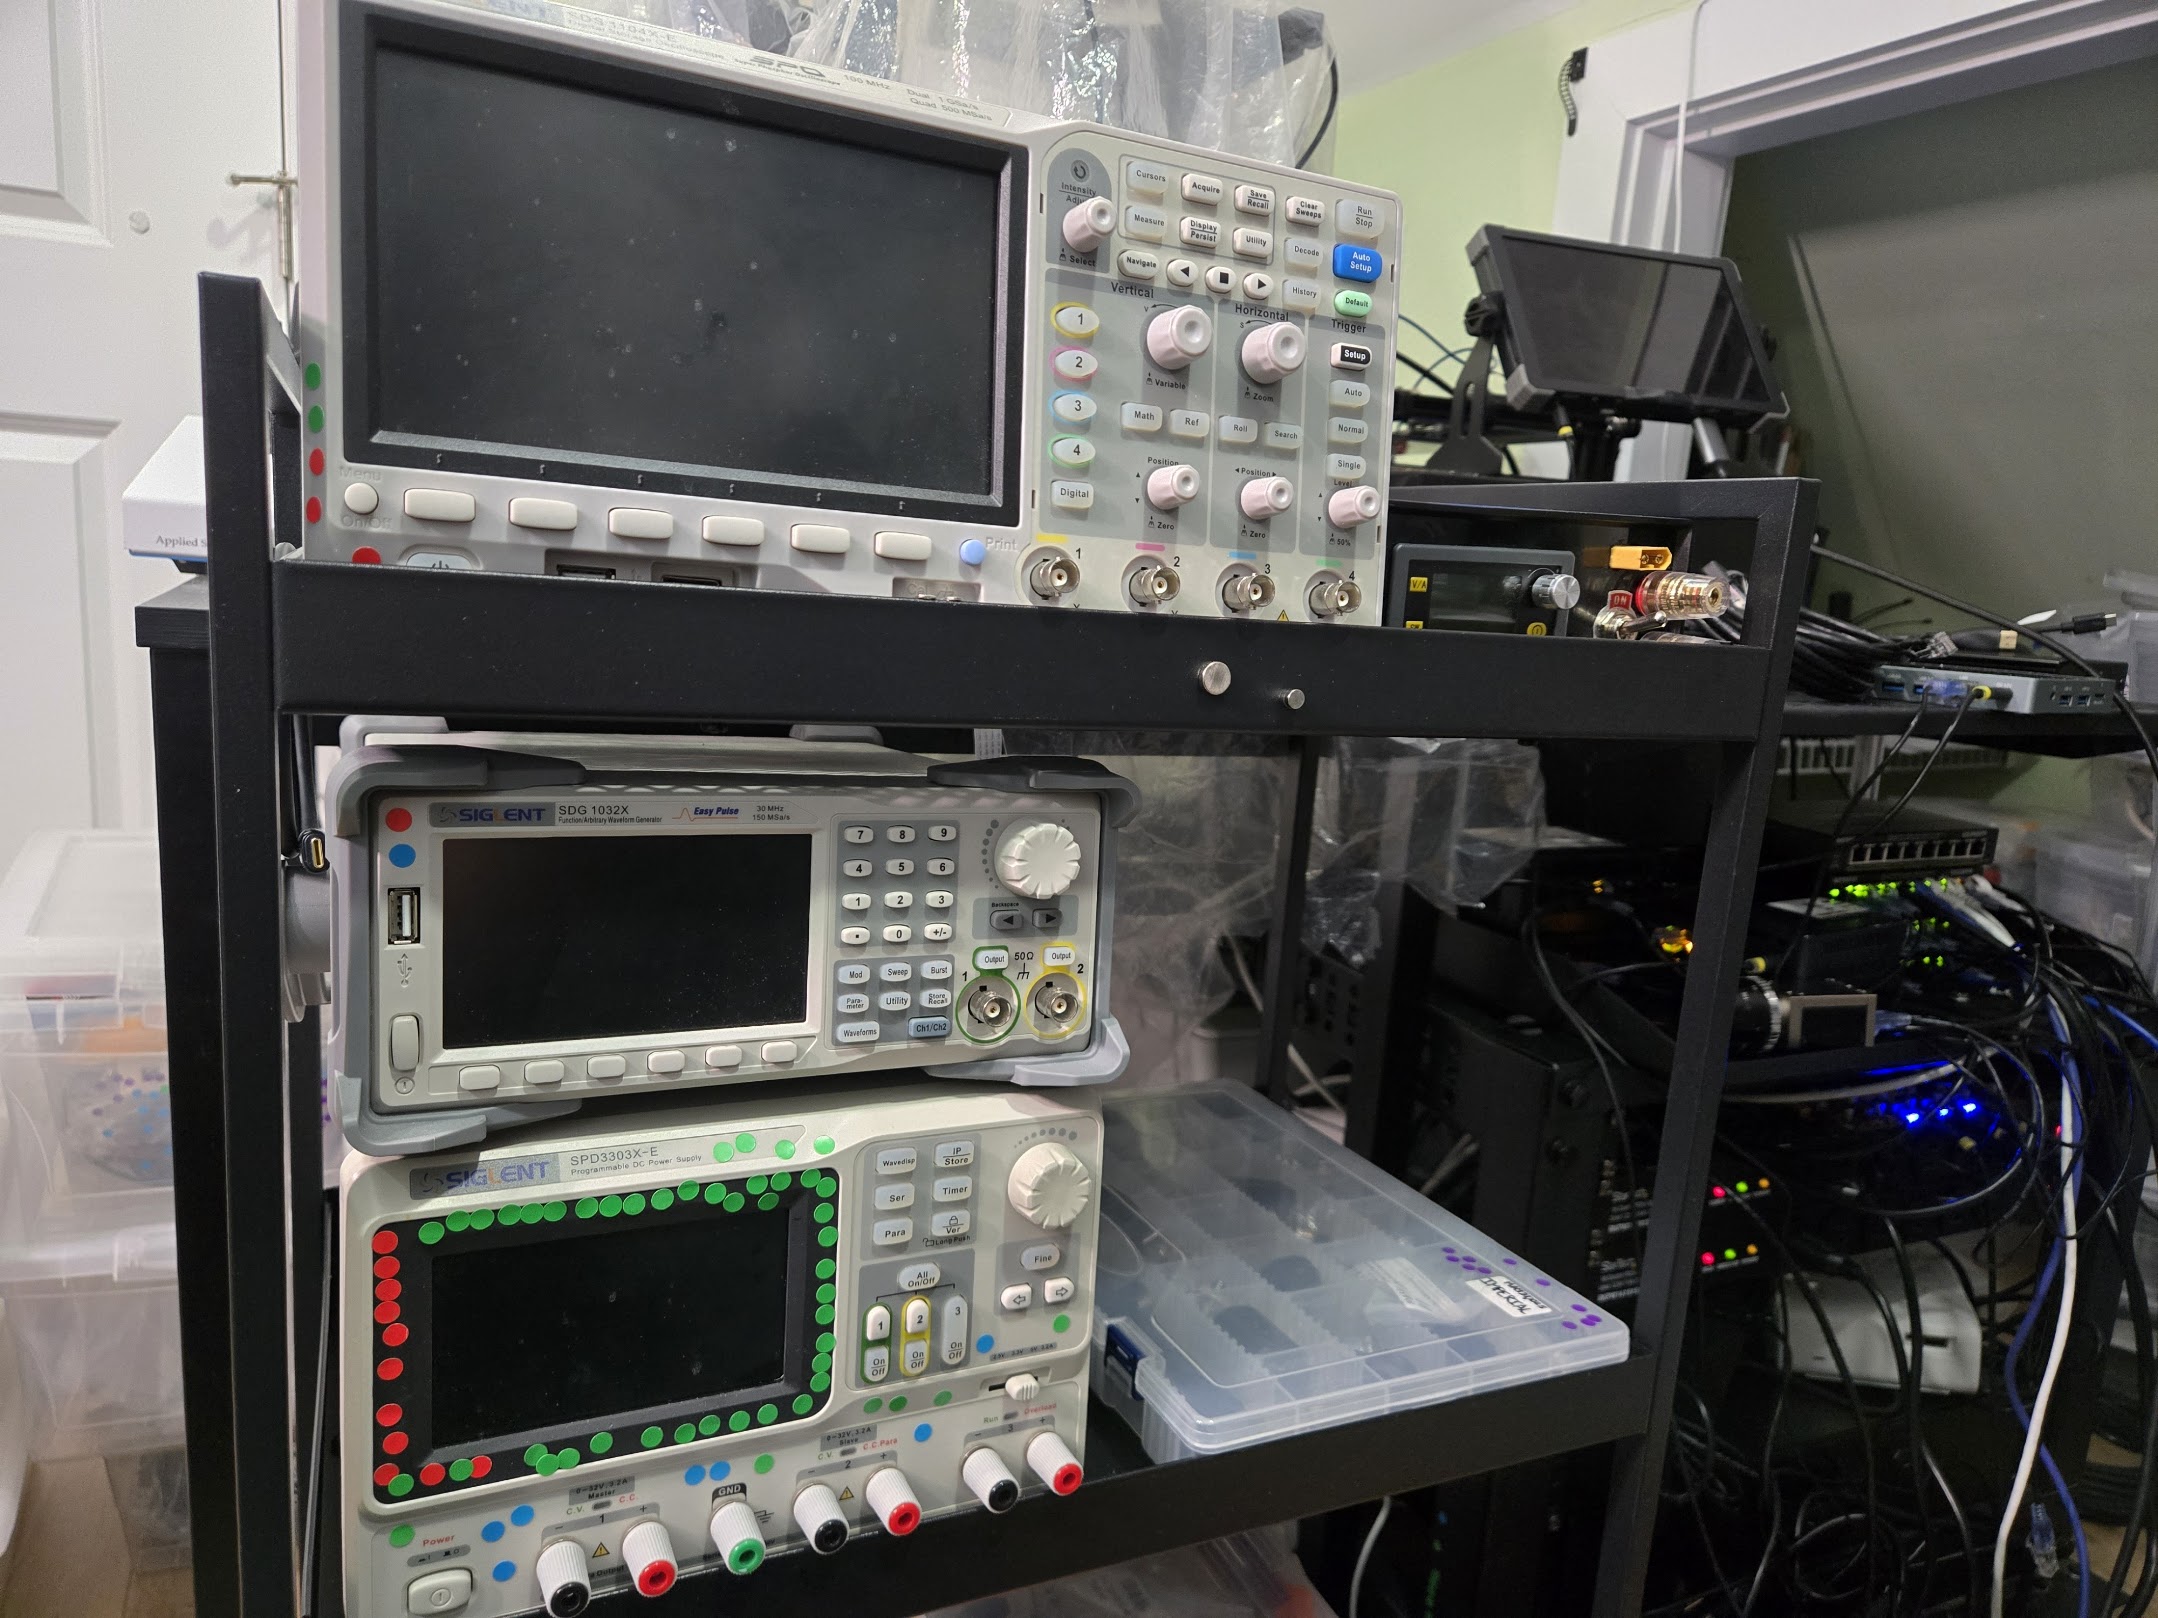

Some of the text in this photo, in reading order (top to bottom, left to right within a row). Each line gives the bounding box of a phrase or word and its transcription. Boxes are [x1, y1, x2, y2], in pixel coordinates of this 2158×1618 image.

[844, 74, 891, 90] 100 MHz
[906, 88, 979, 112] Dual 1 GSa/s
[909, 97, 993, 122] Quad 500 MSa/s
[1136, 169, 1166, 183] Cursors
[1061, 182, 1097, 197] Intensity
[1191, 181, 1221, 195] Acquire
[1249, 189, 1267, 200] Save
[1247, 198, 1269, 210] Recall
[1300, 200, 1318, 211] Clear
[1295, 207, 1322, 220] Sweeps
[1357, 205, 1373, 216] Run
[1134, 214, 1165, 227] Measure
[1190, 219, 1218, 232] Display
[1355, 217, 1373, 229] Stop
[1190, 231, 1217, 243] Persist
[1246, 235, 1267, 247] Utility
[1294, 245, 1320, 257] Decode
[1352, 251, 1371, 262] Auto
[1069, 254, 1096, 267] Select
[1126, 256, 1157, 269] Navigate
[1350, 261, 1372, 273] Setup
[1110, 281, 1154, 299] Vertical
[1292, 286, 1317, 298] History
[1345, 297, 1369, 308] Default
[1235, 303, 1290, 321] Horizontal
[1077, 313, 1084, 325] 1
[1331, 318, 1367, 334] Trigger
[1343, 349, 1366, 361] Setup
[1075, 356, 1083, 369] 2
[1154, 378, 1186, 390] Variable
[1252, 392, 1274, 402] Zoom
[1344, 387, 1363, 397] Auto
[1074, 399, 1082, 412] 3
[1134, 410, 1155, 421] Math
[1185, 417, 1199, 427] Ref
[1233, 424, 1248, 433] Roll
[1338, 424, 1365, 435] Normal
[1274, 430, 1298, 440] Search
[1072, 444, 1081, 456] 4
[1147, 456, 1179, 466] Position
[1337, 459, 1361, 471] Single
[339, 465, 381, 482] Menu
[1240, 467, 1271, 478] Position
[1333, 478, 1353, 487] Level
[1060, 487, 1089, 499] Digital
[1157, 521, 1175, 530] Zero
[1249, 530, 1266, 539] Zero
[156, 535, 198, 548] Applied
[985, 536, 1018, 552] Print
[1336, 538, 1351, 547] 50%
[1075, 547, 1082, 560] 1
[1173, 556, 1180, 567] 2
[1264, 563, 1271, 575] 3
[1348, 570, 1356, 581] 4
[1412, 580, 1427, 589] V/A
[1613, 595, 1627, 605] ON
[459, 805, 629, 822] SIGLENT SDG 1032X
[693, 806, 740, 817] Easy Pulse
[558, 815, 663, 825] Function/Arbitrary Waveform Generator
[857, 828, 947, 840] 7 8 9
[855, 862, 946, 874] 4 5 6
[855, 895, 945, 906] 1 2 3
[896, 927, 947, 940] 0 +/-
[984, 954, 1005, 965] Output
[1051, 951, 1072, 961] Output
[849, 966, 948, 980] Mod Sweep Burst
[1076, 963, 1084, 974] 2
[962, 971, 969, 982] 1
[845, 997, 863, 1005] Para-
[885, 996, 909, 1008] Utility
[928, 993, 946, 1001] Store
[928, 997, 949, 1005] Recall
[846, 1002, 865, 1010] meter
[843, 1023, 947, 1038] Waveforms Ch1/Ch2
[952, 1147, 962, 1155] IP
[570, 1153, 703, 1177] Programmable DC Power Supply
[882, 1157, 916, 1168] Wavedisp
[944, 1156, 969, 1166] Store
[445, 1146, 659, 1190] SIGLENT SPD3303X-E
[942, 1185, 968, 1196] Timer
[889, 1193, 906, 1203] Ser
[884, 1228, 906, 1238] Para
[945, 1225, 961, 1235] Ver
[935, 1234, 971, 1247] Long Push
[1034, 1253, 1053, 1264] Fine
[916, 1271, 929, 1280] All
[907, 1276, 936, 1288] On/Off
[1480, 1276, 1532, 1315] IMPERIAL
[954, 1306, 961, 1316] 3
[916, 1314, 924, 1325] 2
[877, 1321, 884, 1331] 1
[949, 1341, 963, 1350] On
[912, 1350, 925, 1359] On
[948, 1350, 962, 1360] Off
[872, 1357, 886, 1367] On
[910, 1359, 925, 1369] Off
[871, 1366, 886, 1377] Off
[1024, 1402, 1057, 1415] Overload
[983, 1416, 999, 1424] Run
[1008, 1423, 1014, 1433] 3
[839, 1438, 859, 1446] Slave
[845, 1460, 852, 1469] 2
[588, 1489, 616, 1500] Master
[718, 1484, 741, 1497] GND
[566, 1506, 585, 1516] C.V.
[599, 1513, 605, 1524] 1
[422, 1534, 456, 1547] Power
[596, 1565, 625, 1577] Output
